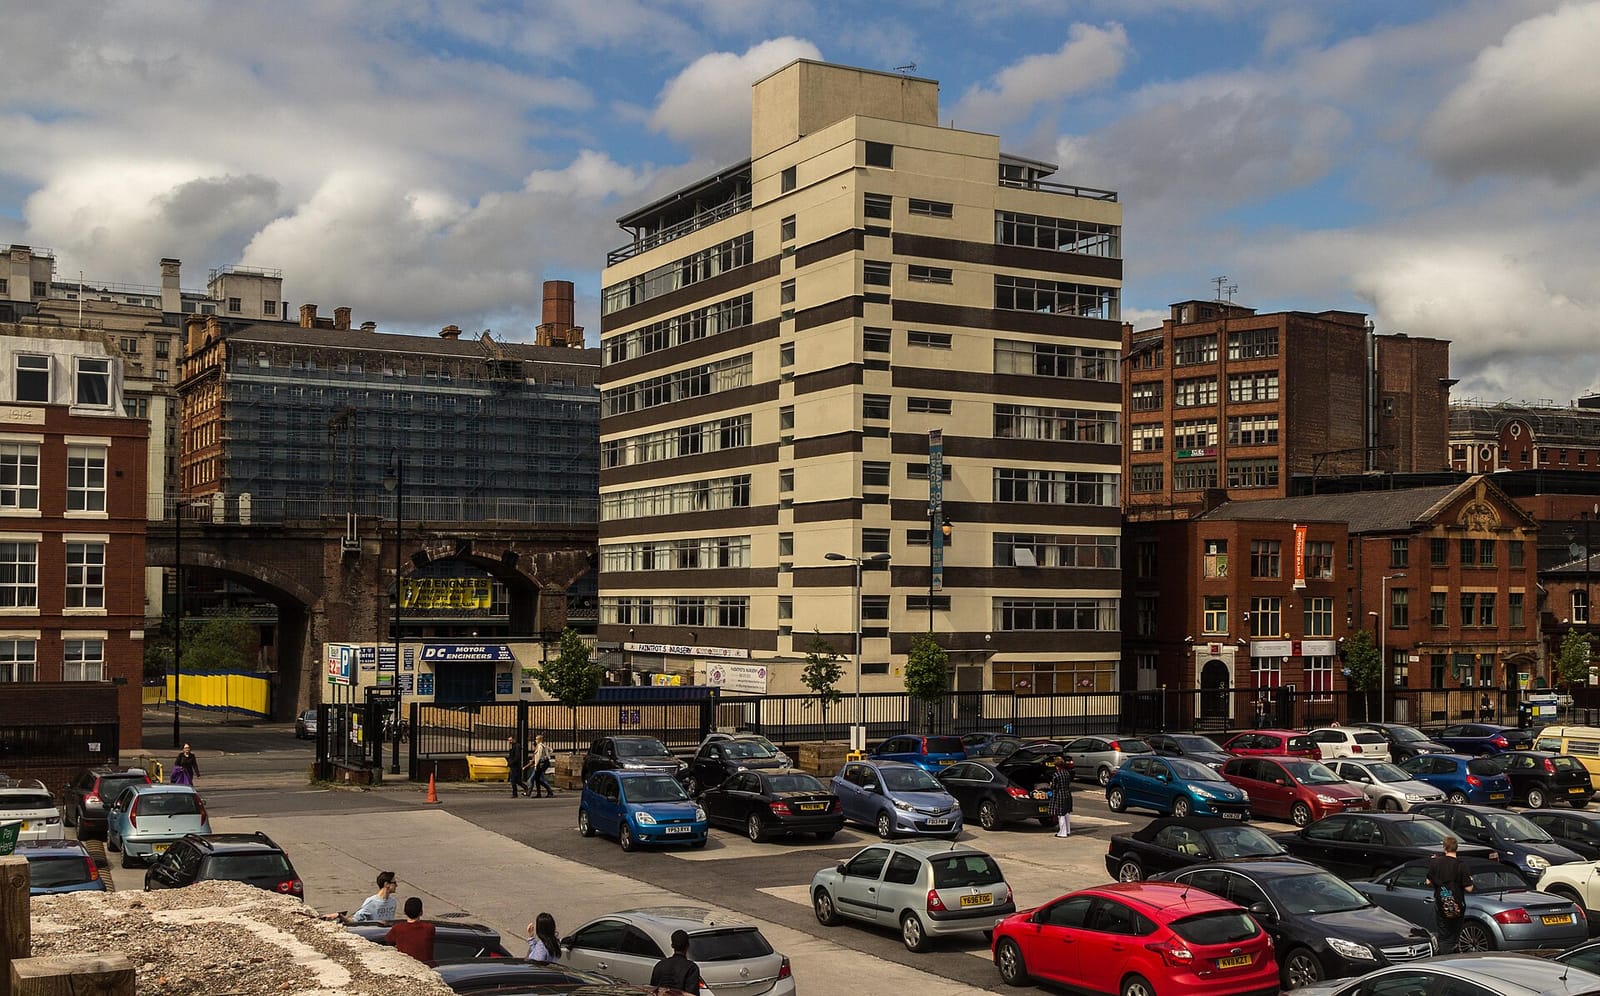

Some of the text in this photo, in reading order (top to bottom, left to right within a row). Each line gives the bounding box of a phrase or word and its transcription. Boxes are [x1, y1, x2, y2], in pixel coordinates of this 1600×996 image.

[425, 648, 446, 658] DC
[342, 649, 349, 675] P
[0, 841, 14, 851] Here
